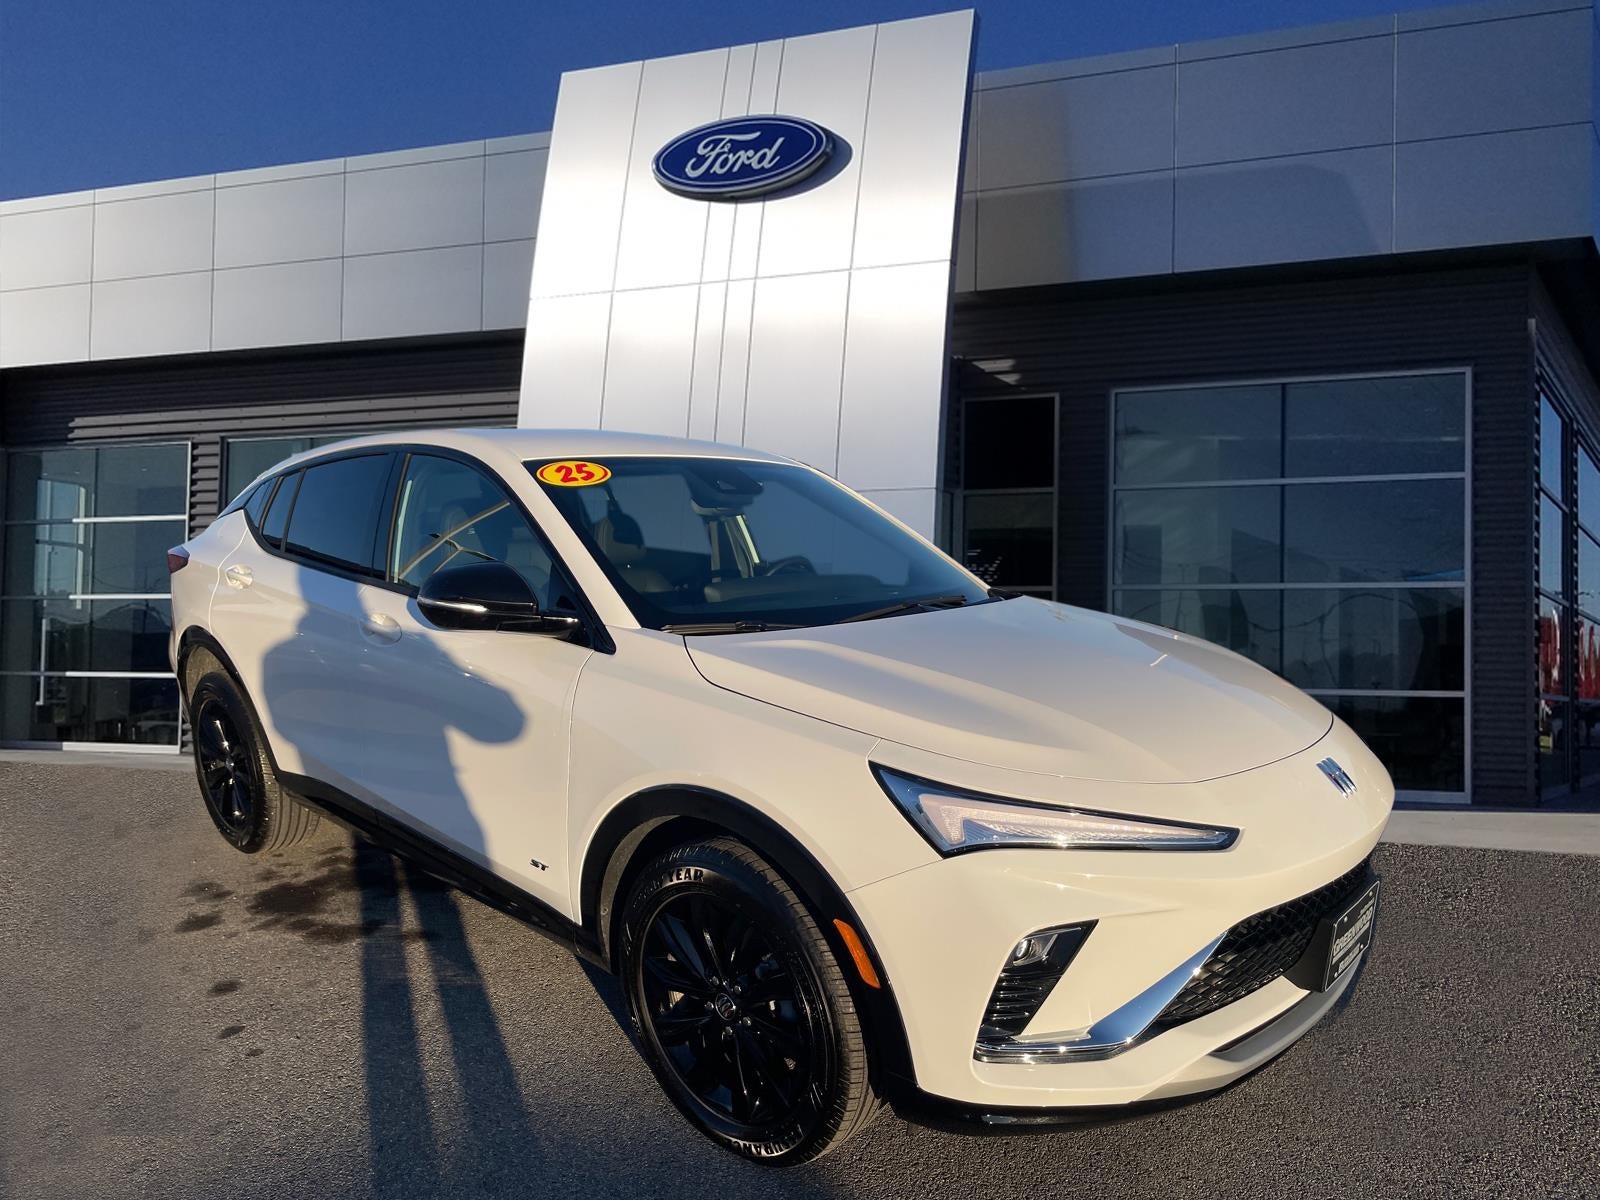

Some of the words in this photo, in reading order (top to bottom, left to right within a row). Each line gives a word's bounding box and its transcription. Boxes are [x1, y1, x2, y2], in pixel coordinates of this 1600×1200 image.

[685, 131, 785, 178] Ford
[555, 463, 595, 483] 25
[530, 858, 549, 871] ST
